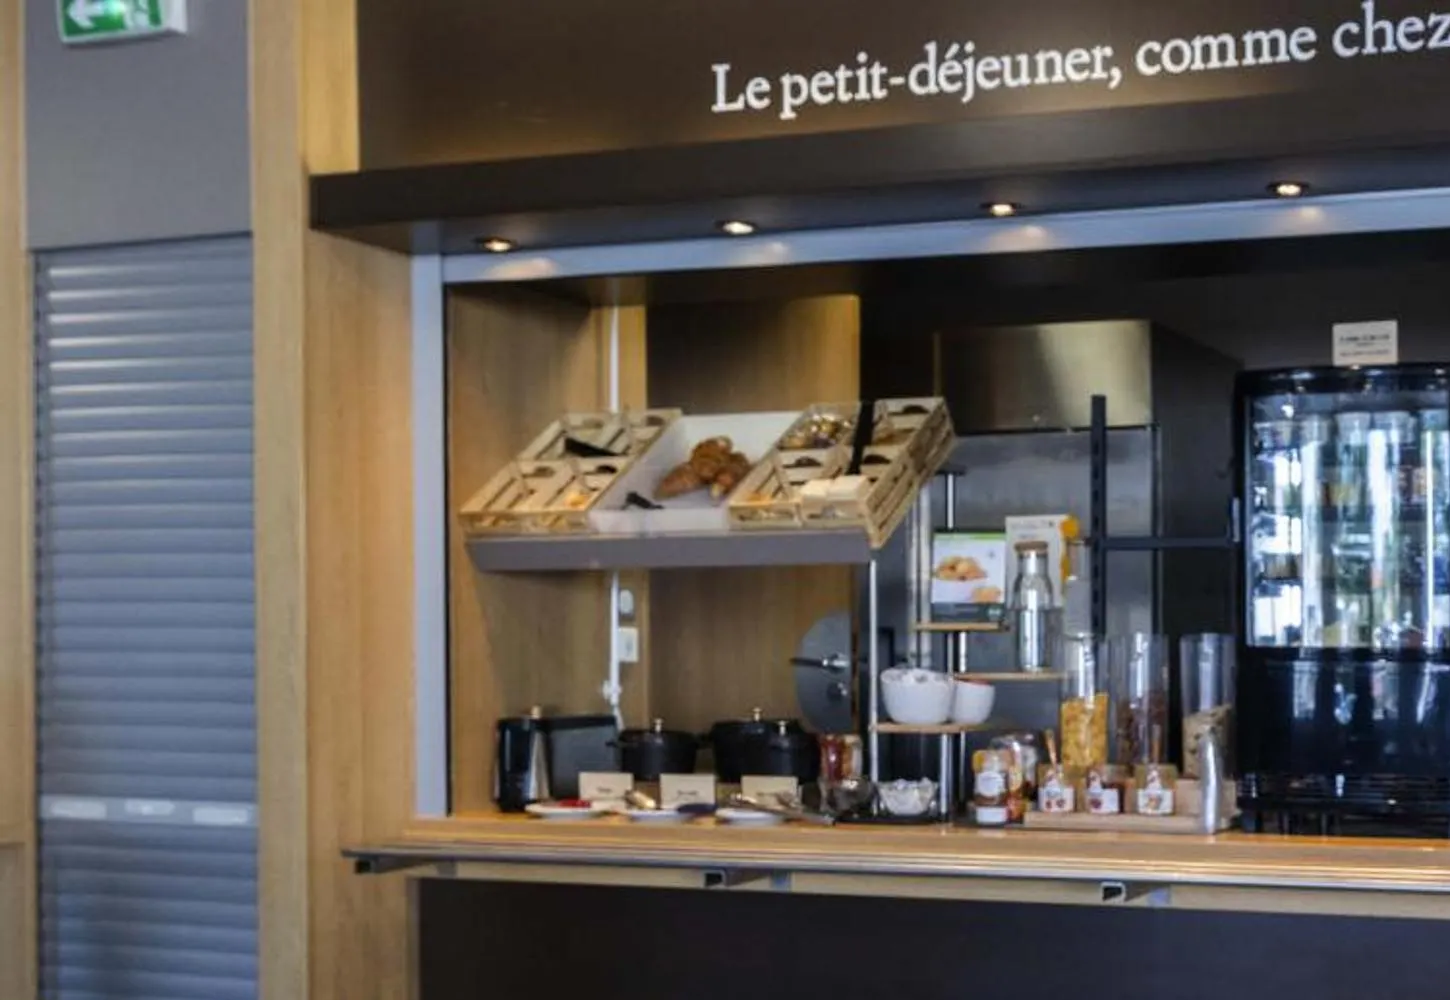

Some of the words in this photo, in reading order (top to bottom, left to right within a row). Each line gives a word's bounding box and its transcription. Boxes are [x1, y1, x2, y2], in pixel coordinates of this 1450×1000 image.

[710, 62, 772, 113] Le
[778, 39, 1122, 120] petit-déjeuner,
[1135, 25, 1317, 76] comme
